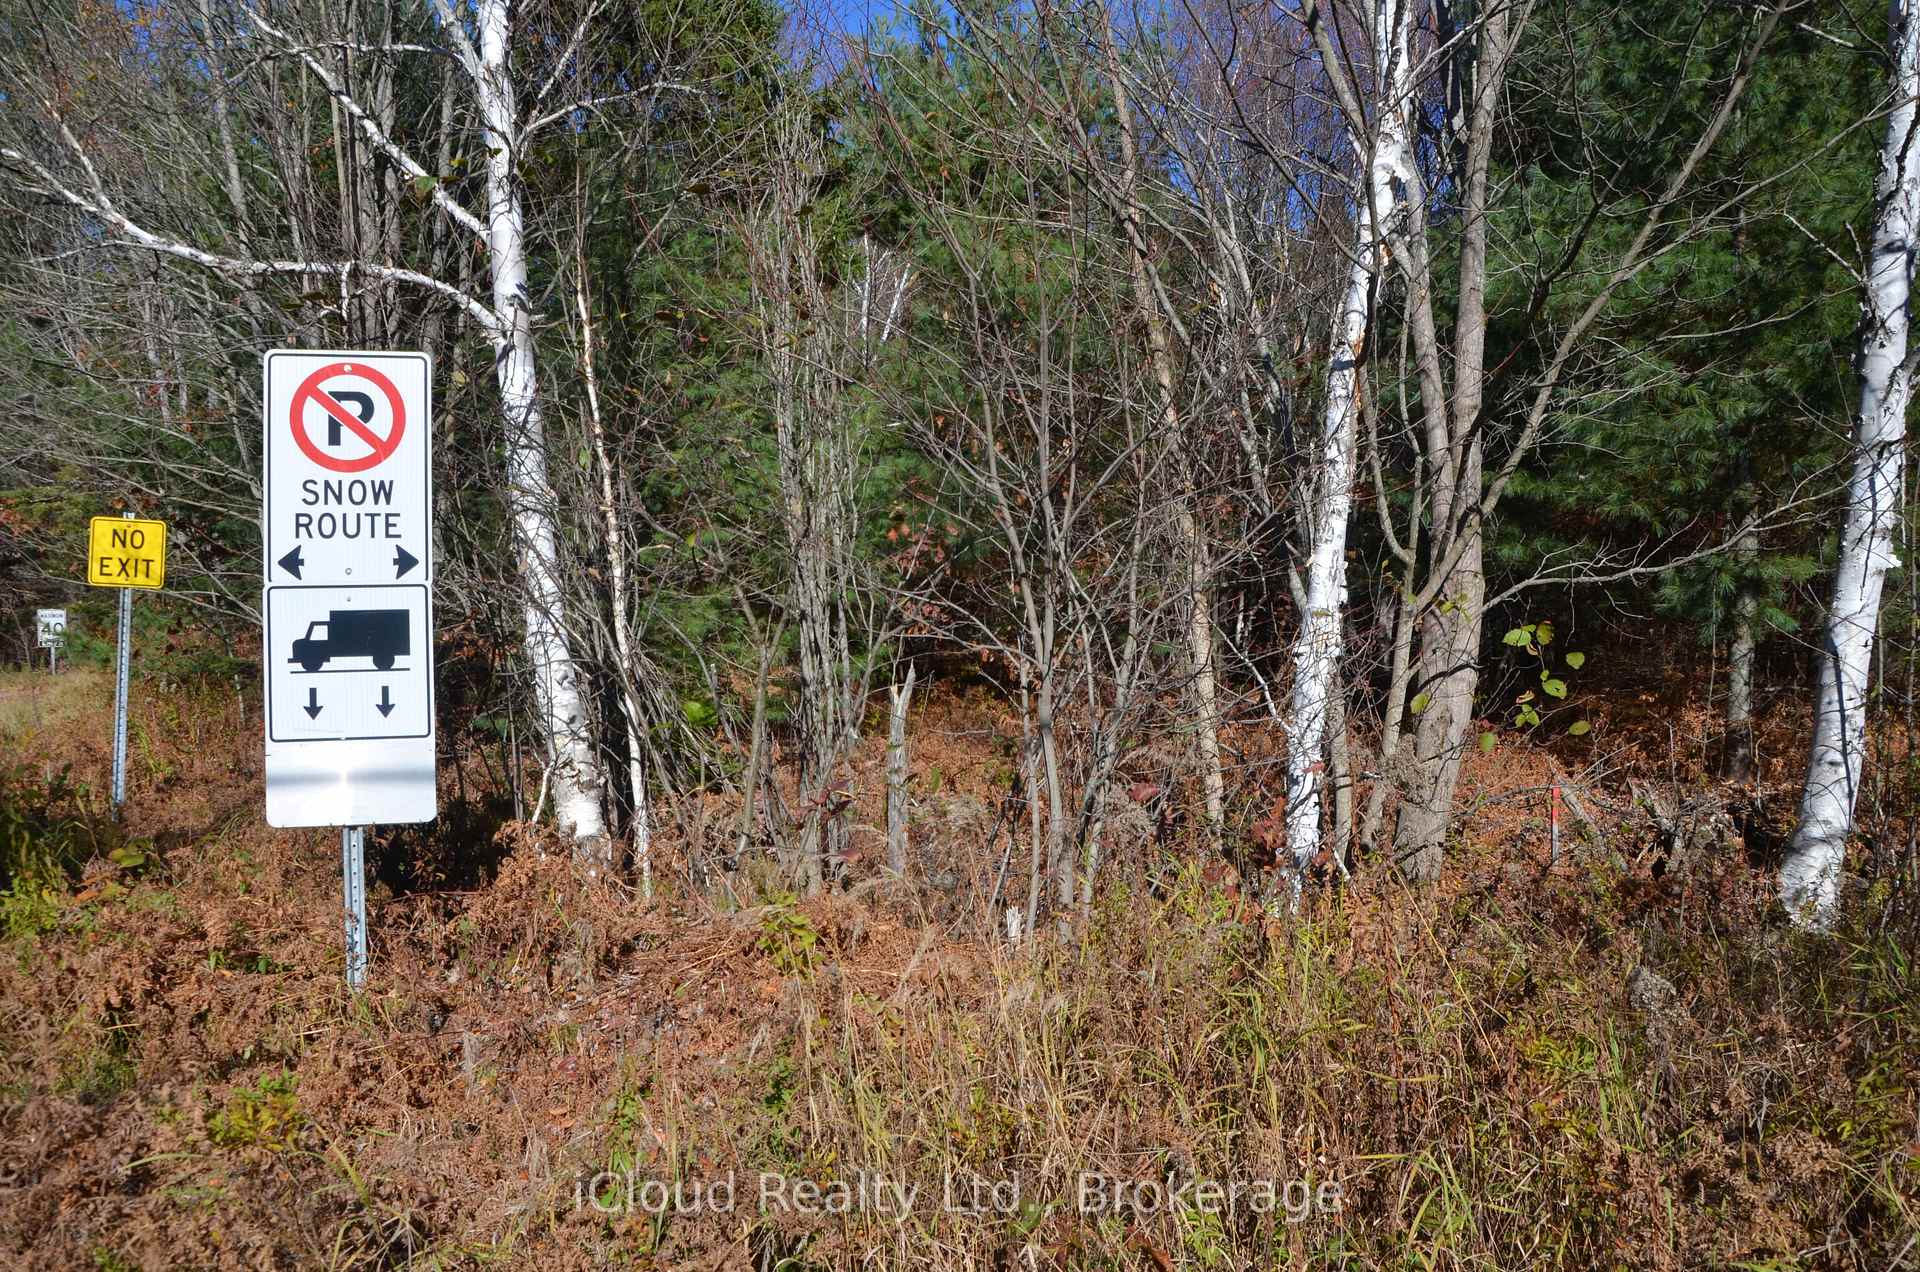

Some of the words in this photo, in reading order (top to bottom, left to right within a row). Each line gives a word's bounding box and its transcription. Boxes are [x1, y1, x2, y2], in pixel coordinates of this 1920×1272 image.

[327, 391, 375, 446] P
[302, 479, 394, 506] SNOW
[112, 528, 145, 549] NO
[295, 512, 402, 539] ROUTE
[100, 556, 154, 578] EXIT
